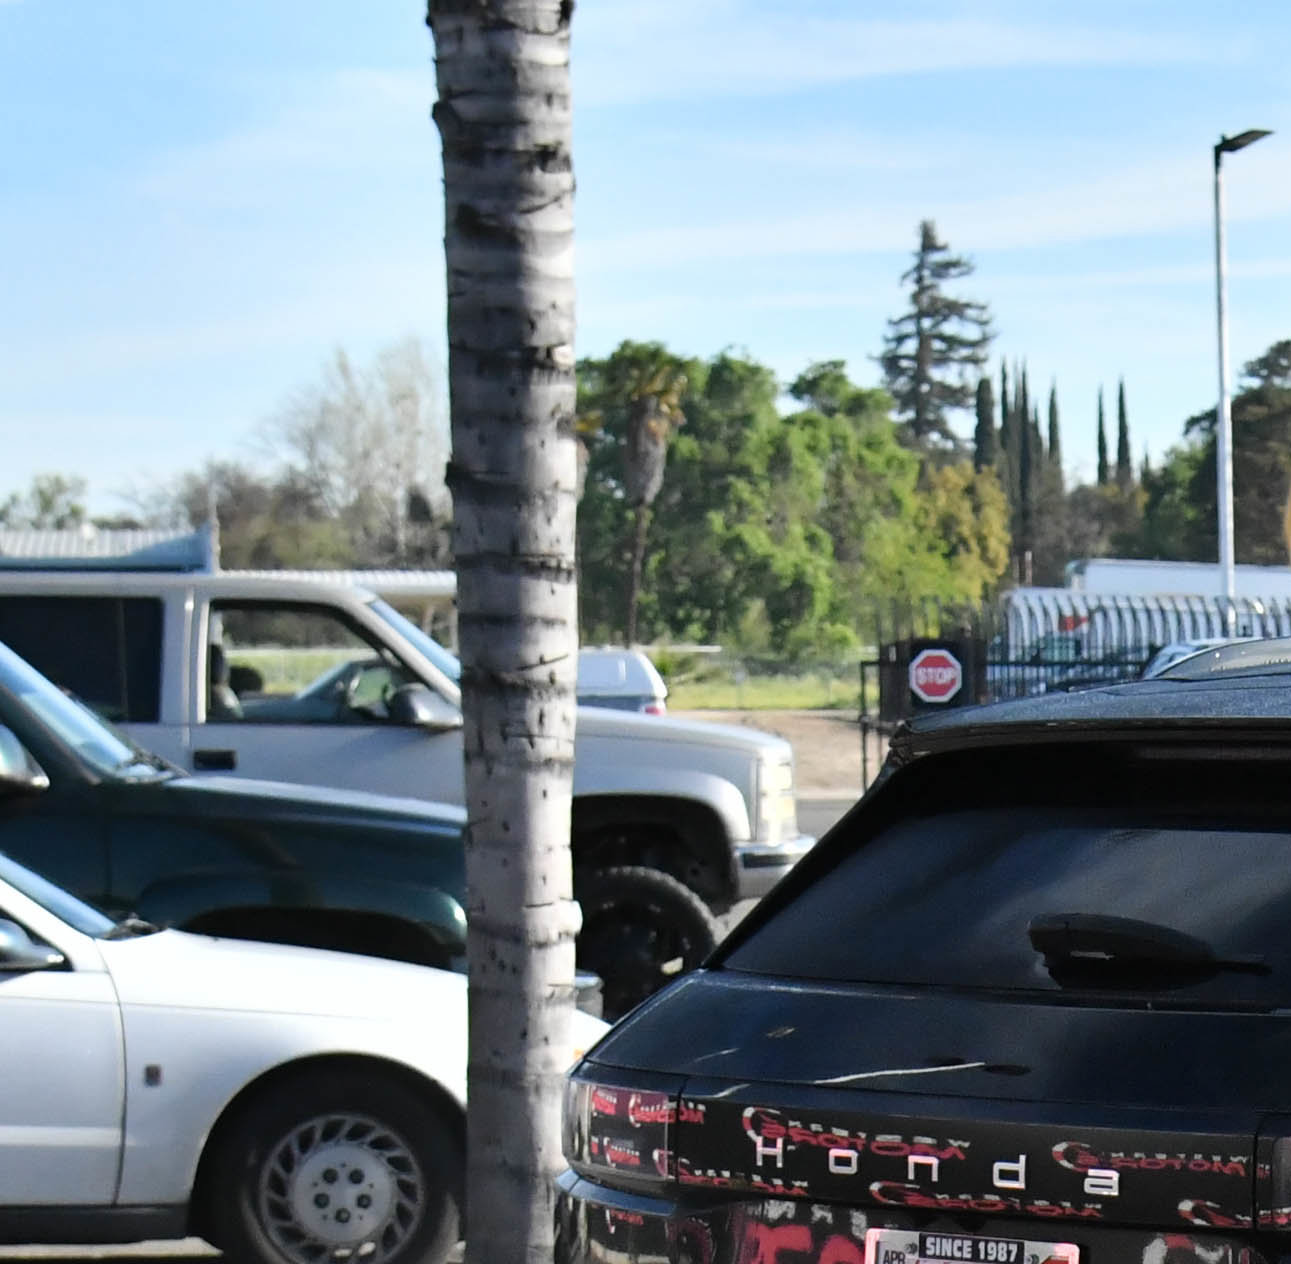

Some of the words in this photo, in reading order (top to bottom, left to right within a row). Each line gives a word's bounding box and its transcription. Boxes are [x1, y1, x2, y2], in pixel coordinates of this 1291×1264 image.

[756, 1136, 1121, 1197] Honda
[925, 1236, 972, 1259] SINCE
[978, 1241, 1018, 1263] 1987
